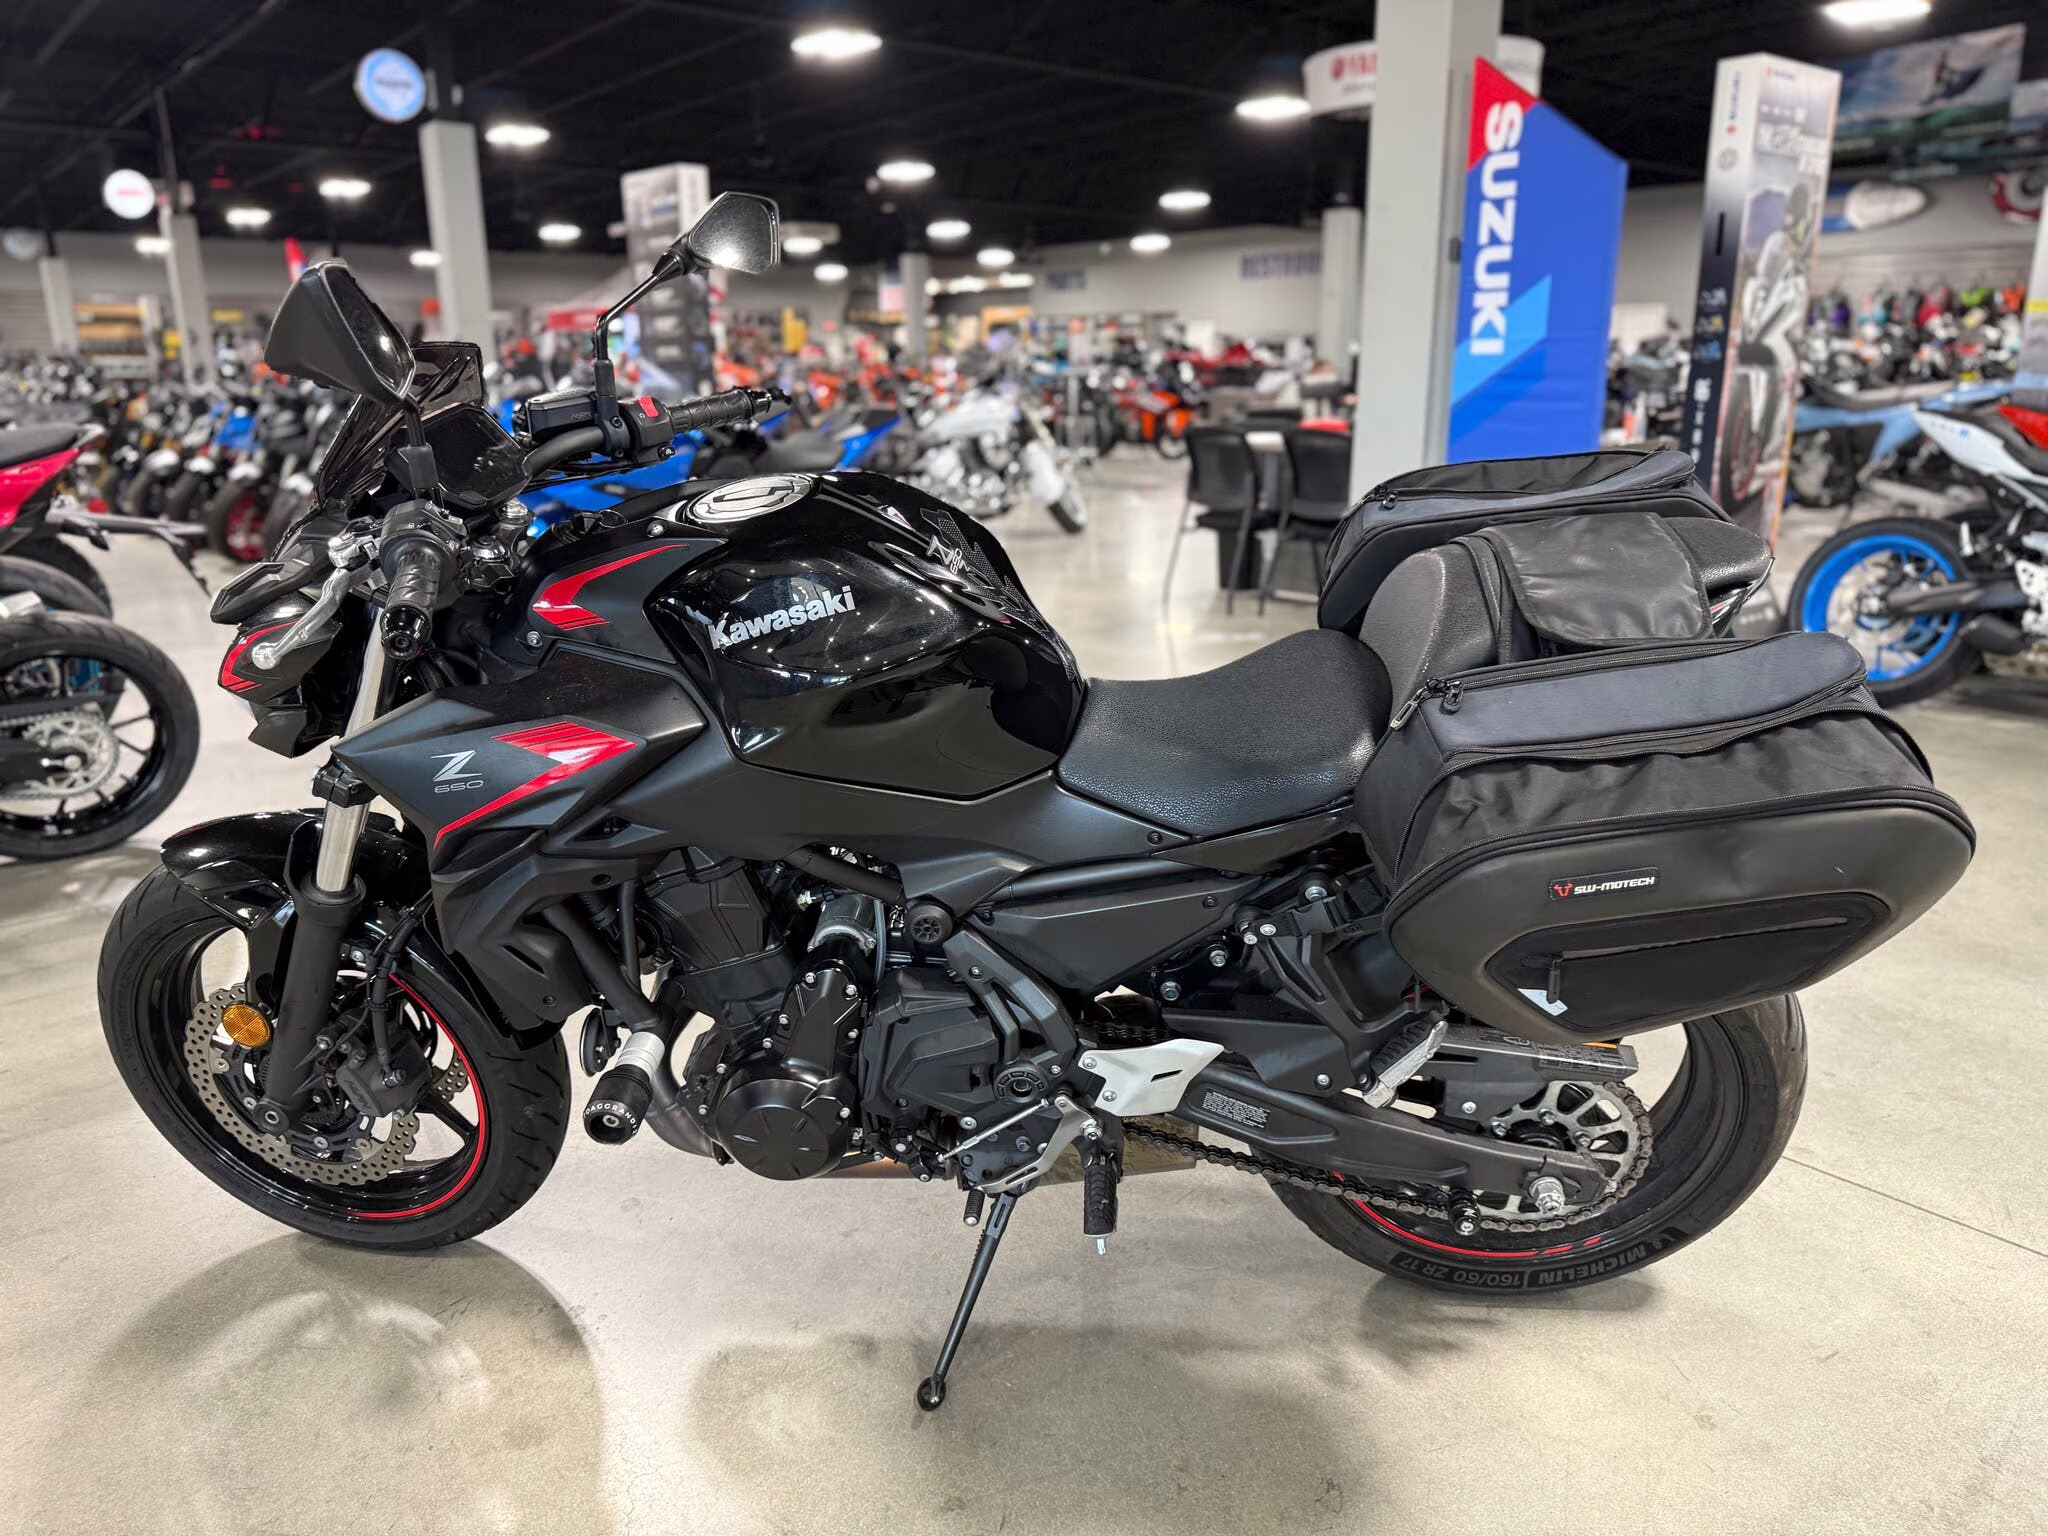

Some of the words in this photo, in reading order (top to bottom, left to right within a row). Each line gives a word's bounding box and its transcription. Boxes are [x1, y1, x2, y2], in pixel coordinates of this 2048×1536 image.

[1469, 101, 1524, 356] SUZUKI
[708, 585, 856, 650] Kawasaki
[429, 749, 483, 782] Z
[434, 780, 484, 794] 650
[1573, 877, 1655, 895] SW-MOTECH
[1400, 1257, 1419, 1270] 17
[1421, 1263, 1449, 1279] ZR
[1537, 1243, 1647, 1285] MICHELIN
[1453, 1270, 1520, 1286] 160/60
